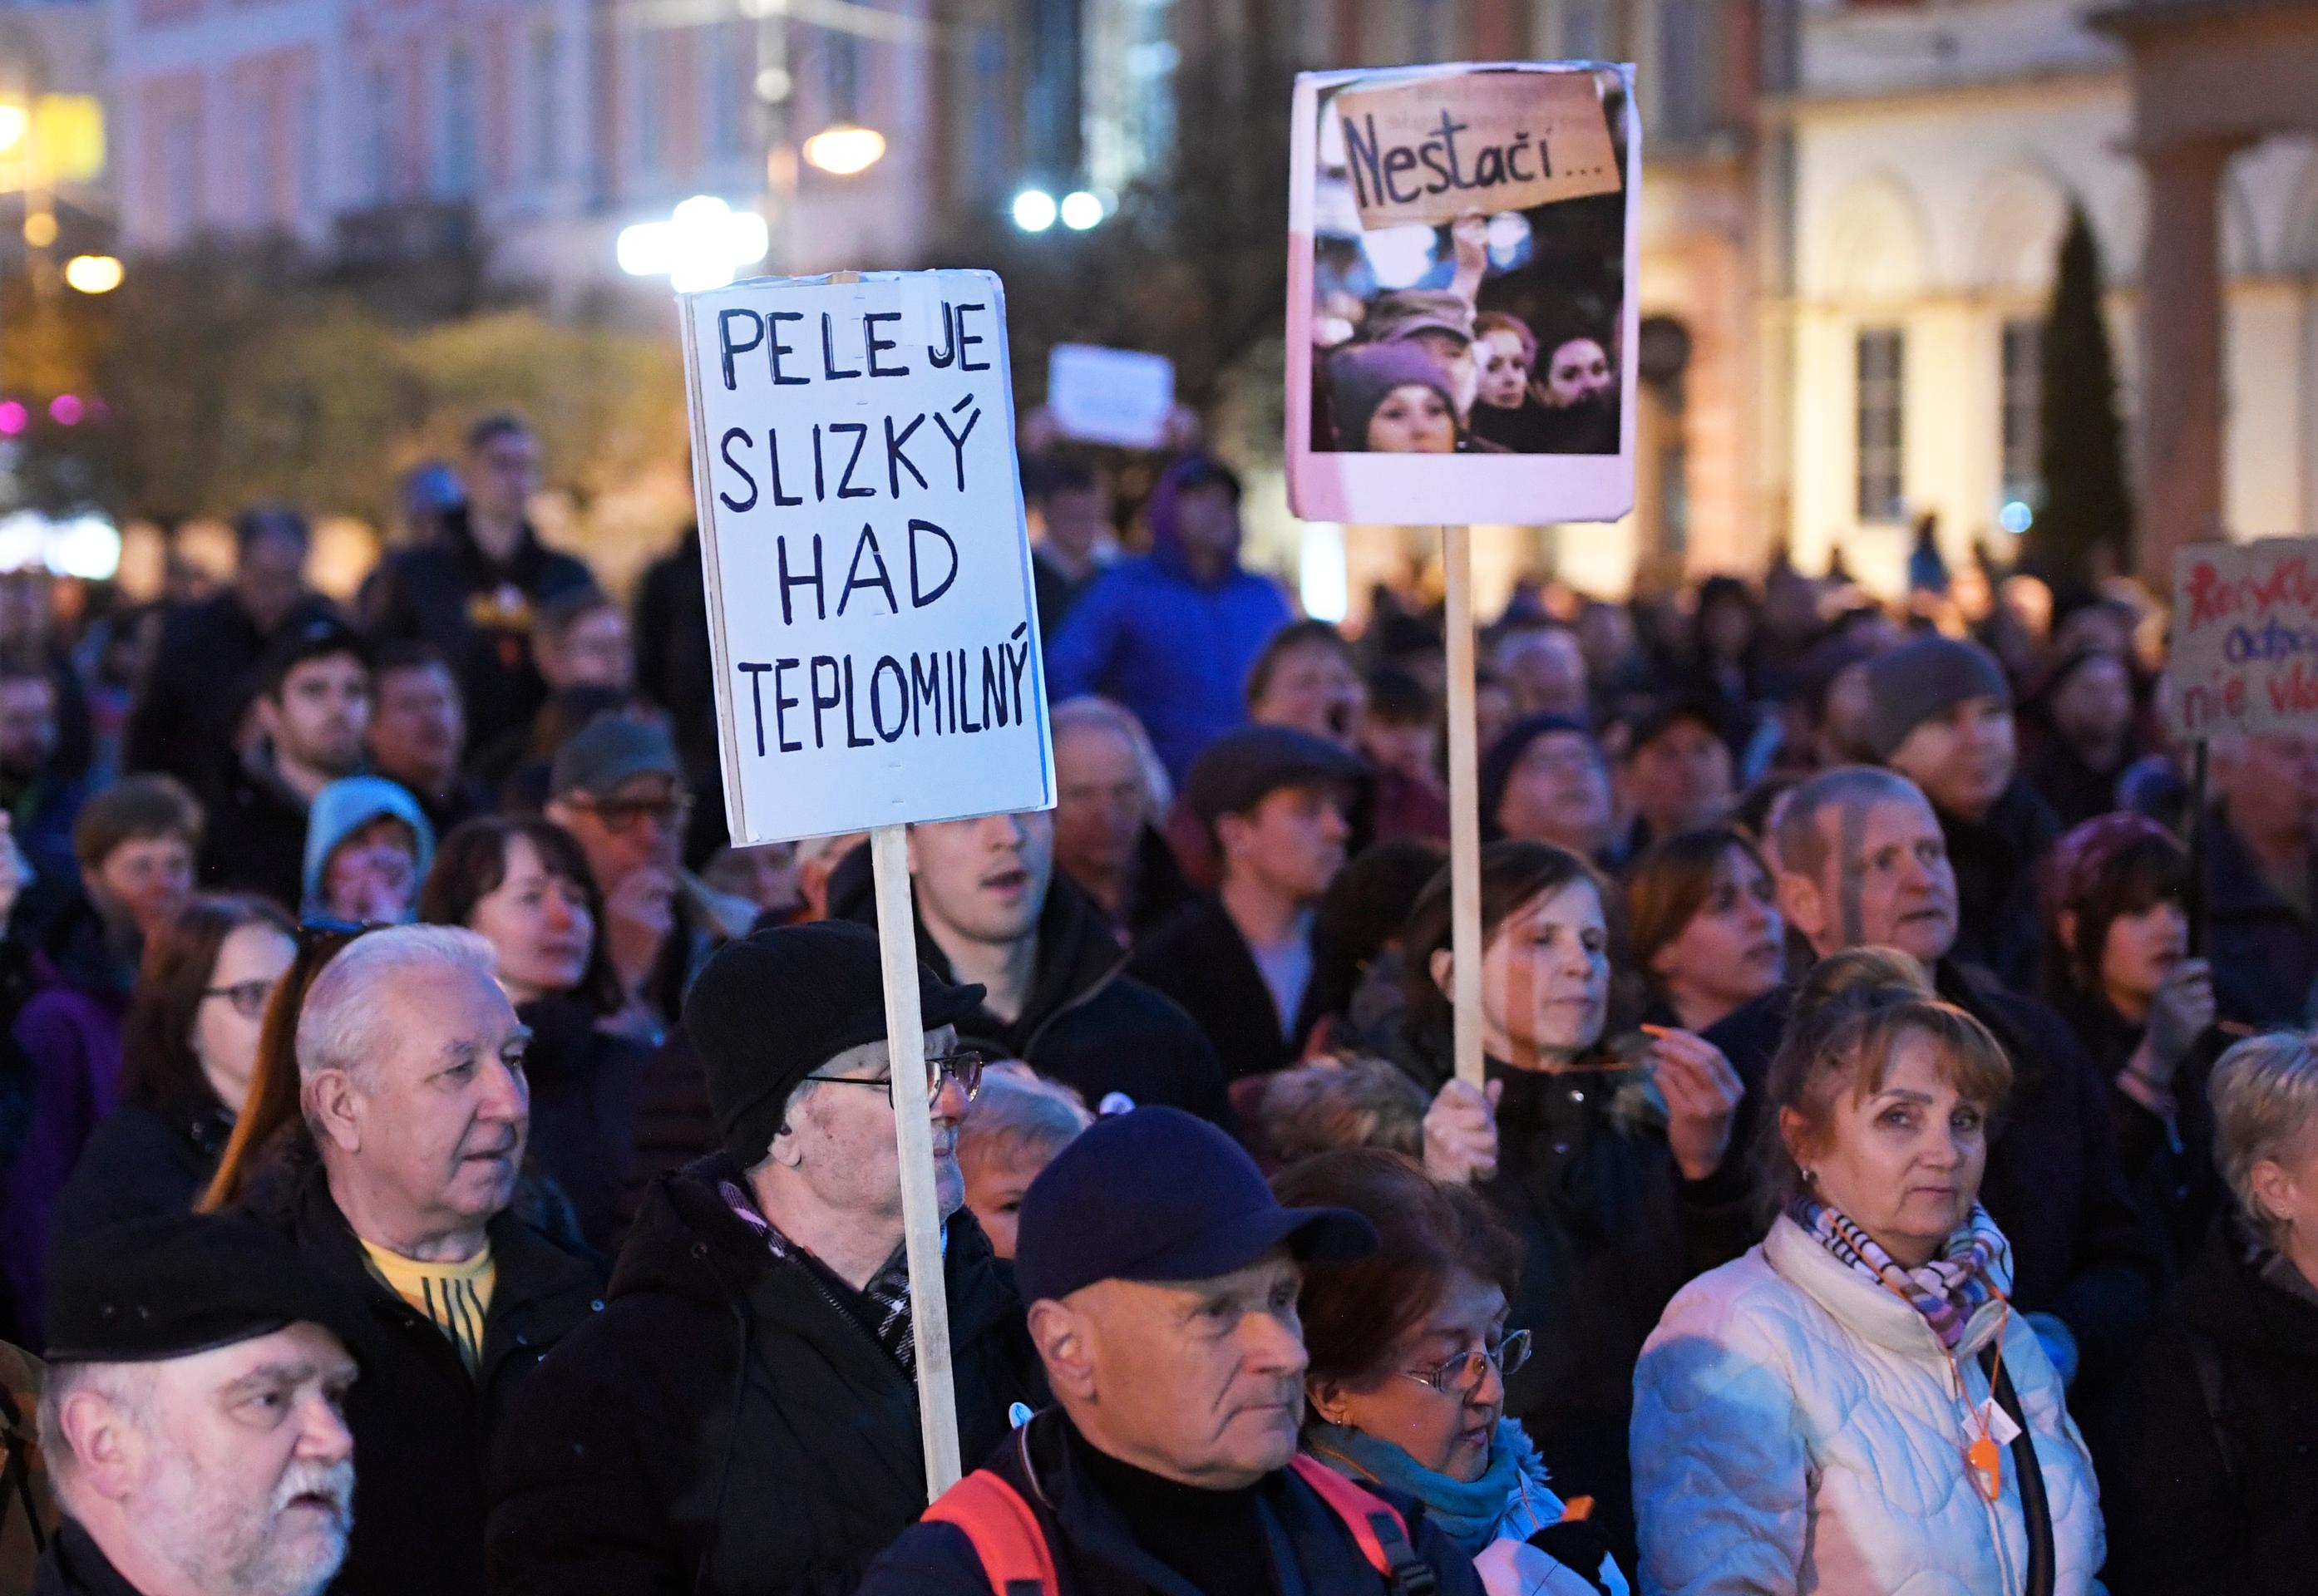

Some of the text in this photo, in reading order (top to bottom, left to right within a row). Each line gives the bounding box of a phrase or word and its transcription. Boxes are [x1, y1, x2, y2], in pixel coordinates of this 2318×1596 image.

[718, 299, 990, 390] PELE JE
[719, 393, 981, 513] SLIZKÝ
[777, 519, 959, 626] HAD
[737, 621, 1028, 757] TEPLOMILNÝ
